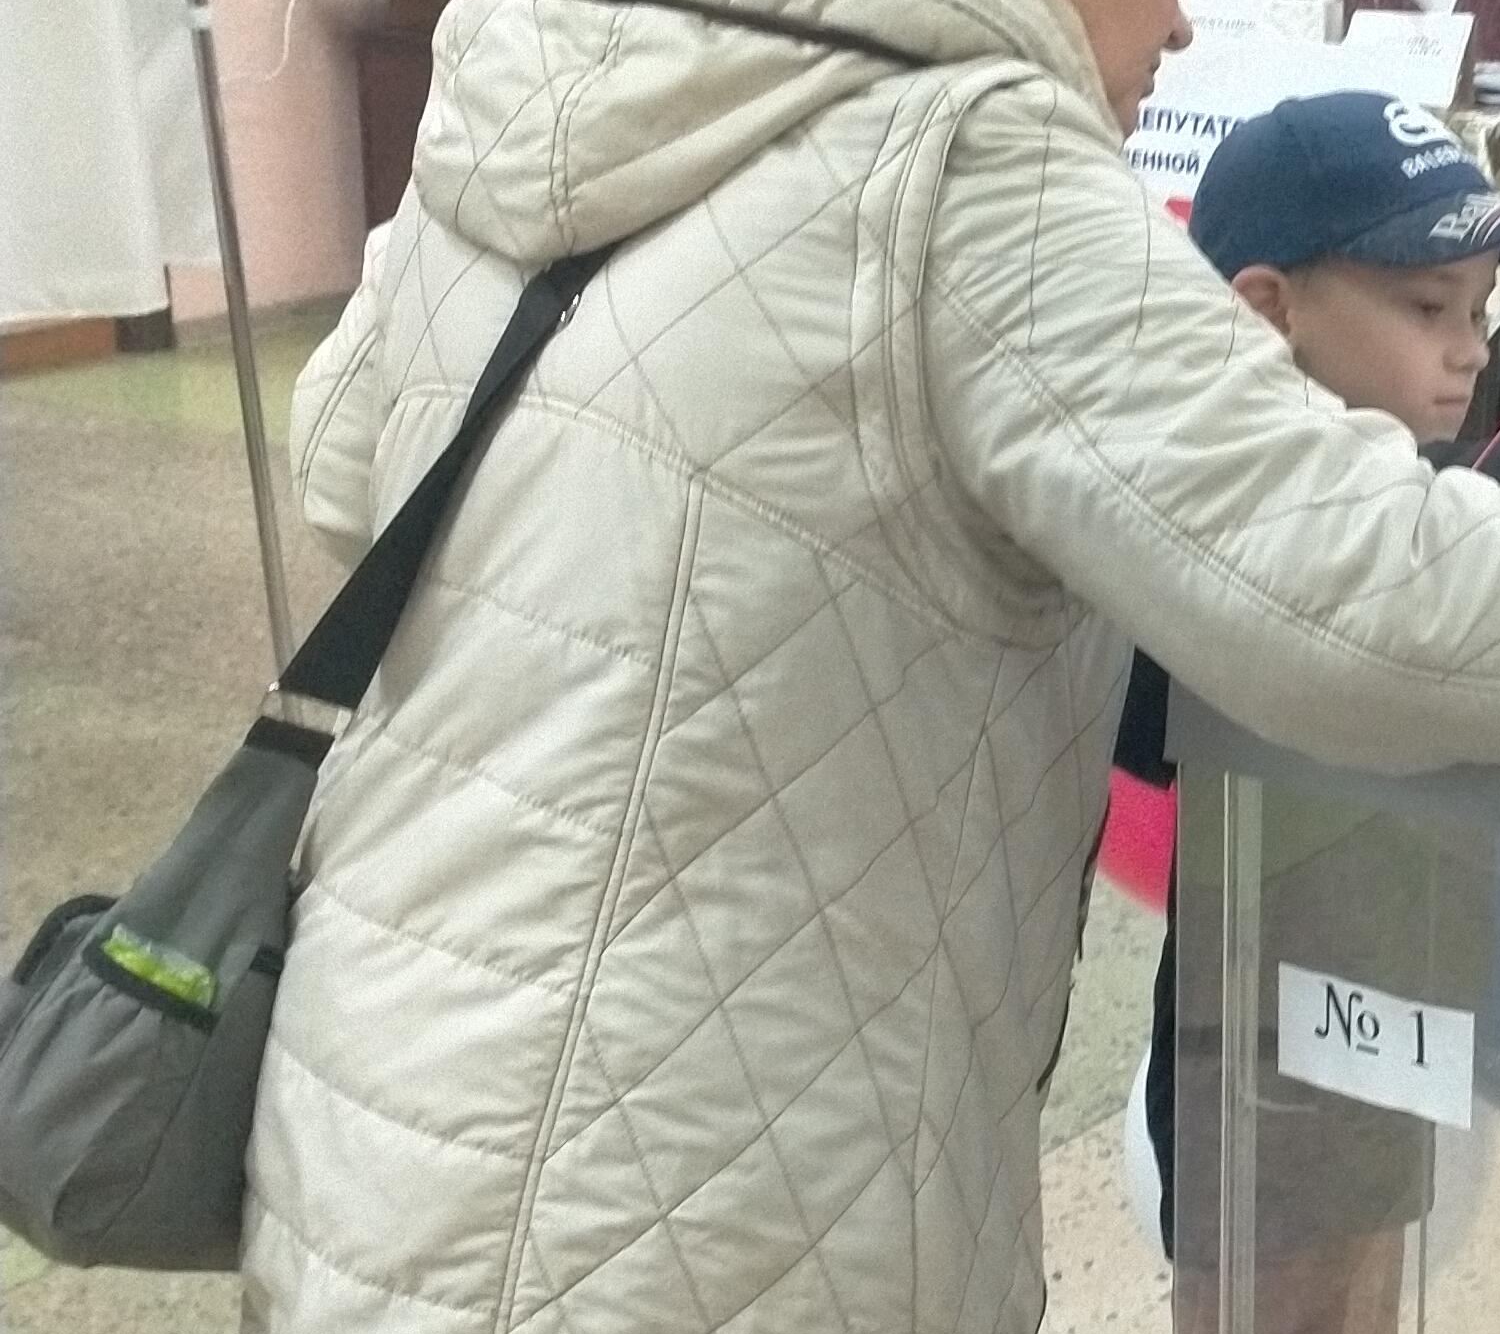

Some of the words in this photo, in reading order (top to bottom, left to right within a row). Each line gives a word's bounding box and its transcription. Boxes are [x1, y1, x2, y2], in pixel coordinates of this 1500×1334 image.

[1137, 107, 1246, 141] ЕПУТАТ
[1121, 148, 1201, 175] ЕННОЙ
[1314, 981, 1380, 1056] №
[1410, 1010, 1427, 1066] 1
